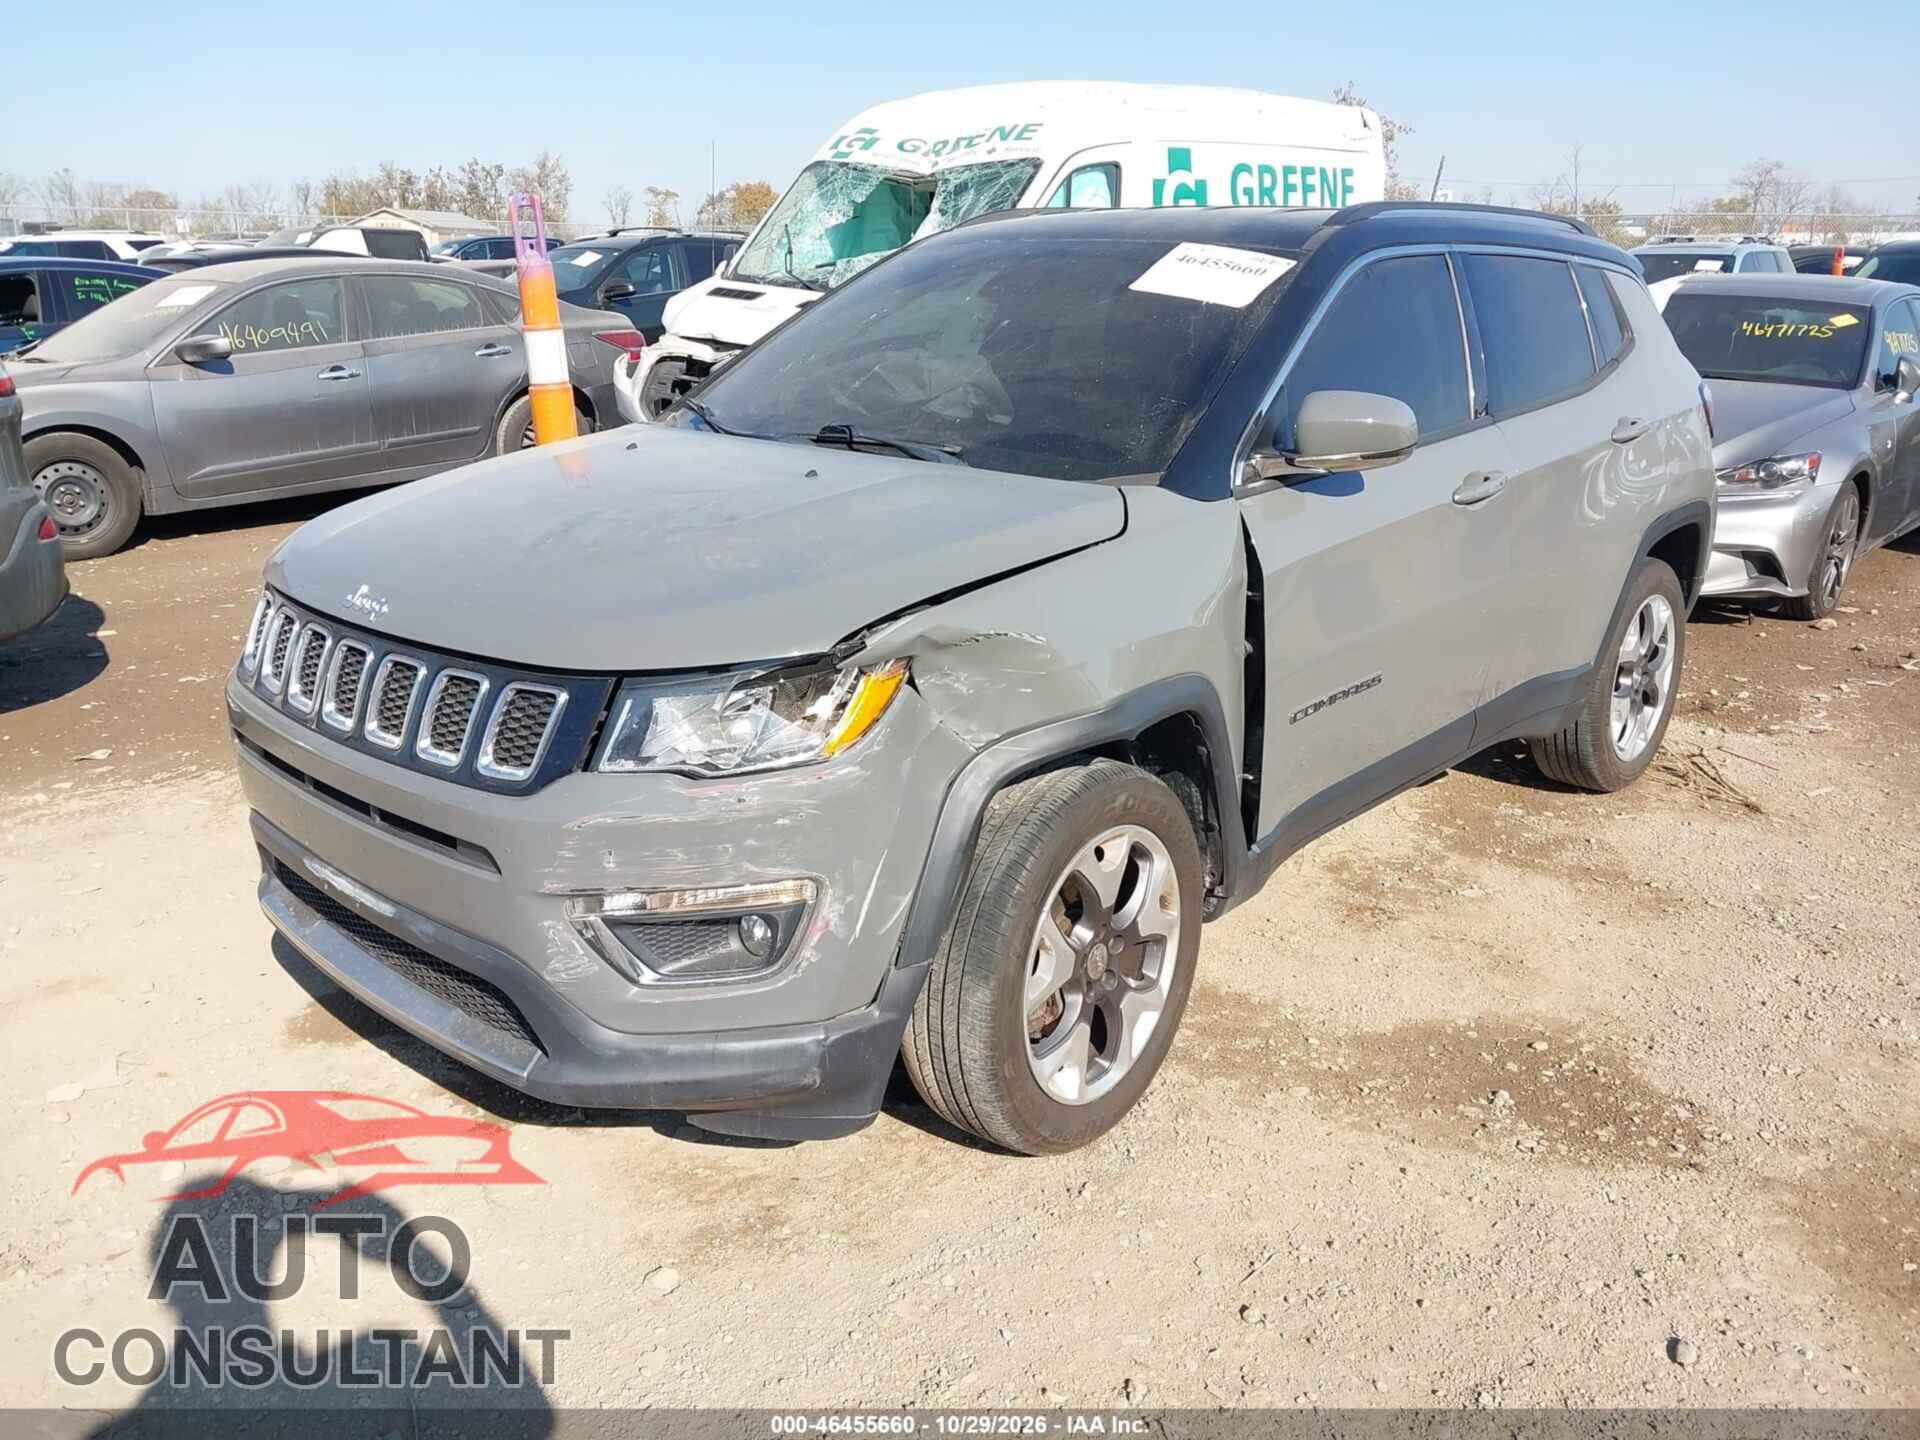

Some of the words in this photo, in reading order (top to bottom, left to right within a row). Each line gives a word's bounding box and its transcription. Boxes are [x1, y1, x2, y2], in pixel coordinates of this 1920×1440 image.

[1231, 163, 1355, 208] GREENE
[218, 320, 329, 350] 46409491
[1742, 321, 1836, 338] 46471725
[1289, 673, 1383, 725] COMPASS
